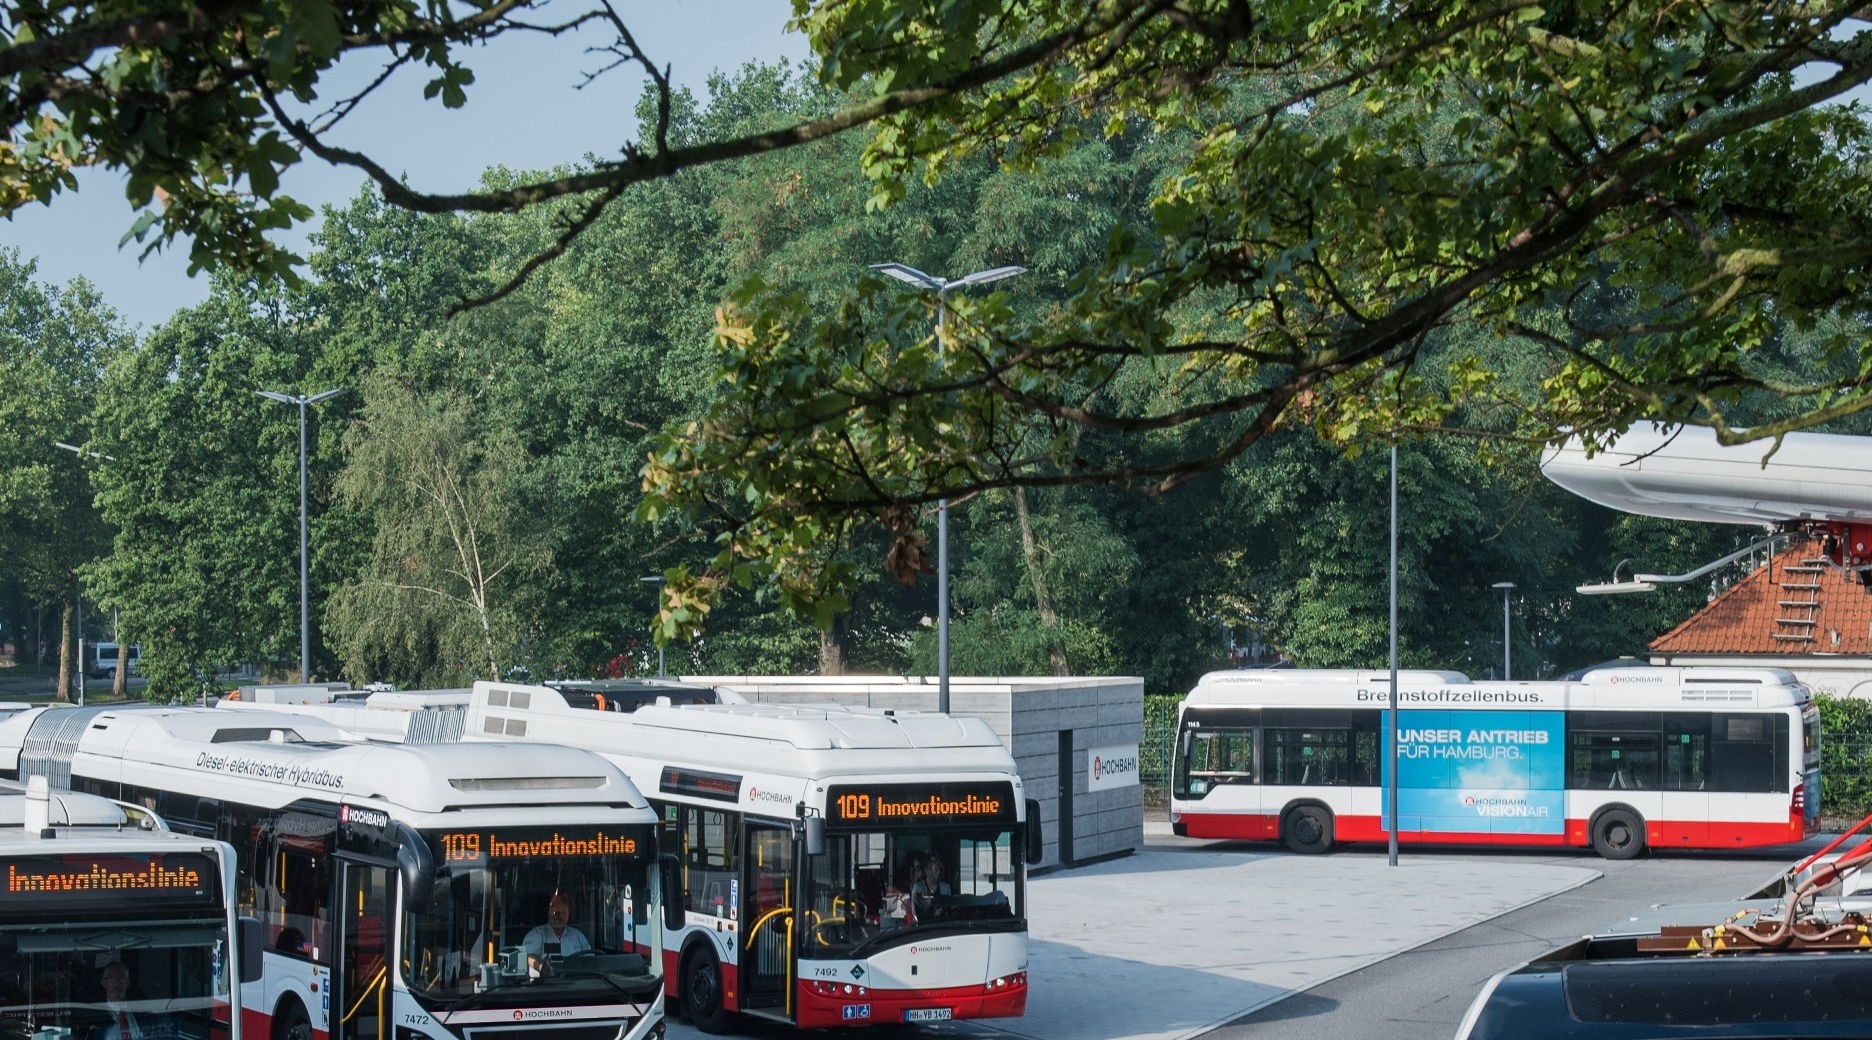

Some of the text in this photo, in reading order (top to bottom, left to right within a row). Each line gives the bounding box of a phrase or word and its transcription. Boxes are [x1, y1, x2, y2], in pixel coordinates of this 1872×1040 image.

[1619, 676, 1663, 684] HOCHBAHN
[1357, 689, 1544, 703] Brenstoffzellenbus.
[1397, 729, 1549, 744] UNSER ANTRIEB
[1397, 743, 1523, 759] FÜR HAMBURG.
[196, 751, 344, 789] Diesel-elektrischer Hybridbus.
[1101, 756, 1137, 775] HOCHBAHN
[756, 790, 793, 804] HOCHBAHN
[837, 794, 1000, 819] 109 Innovationslinie
[1477, 807, 1549, 817] VISIONAIR
[349, 809, 387, 828] HOCHBAHN
[441, 831, 636, 860] 109 Innovationslinie
[9, 862, 200, 892] Innovationslinie
[814, 967, 838, 977] 7492
[405, 1014, 429, 1025] 7472
[525, 1010, 573, 1018] HOCHBAHN
[909, 1009, 951, 1020] HH YB 1492
